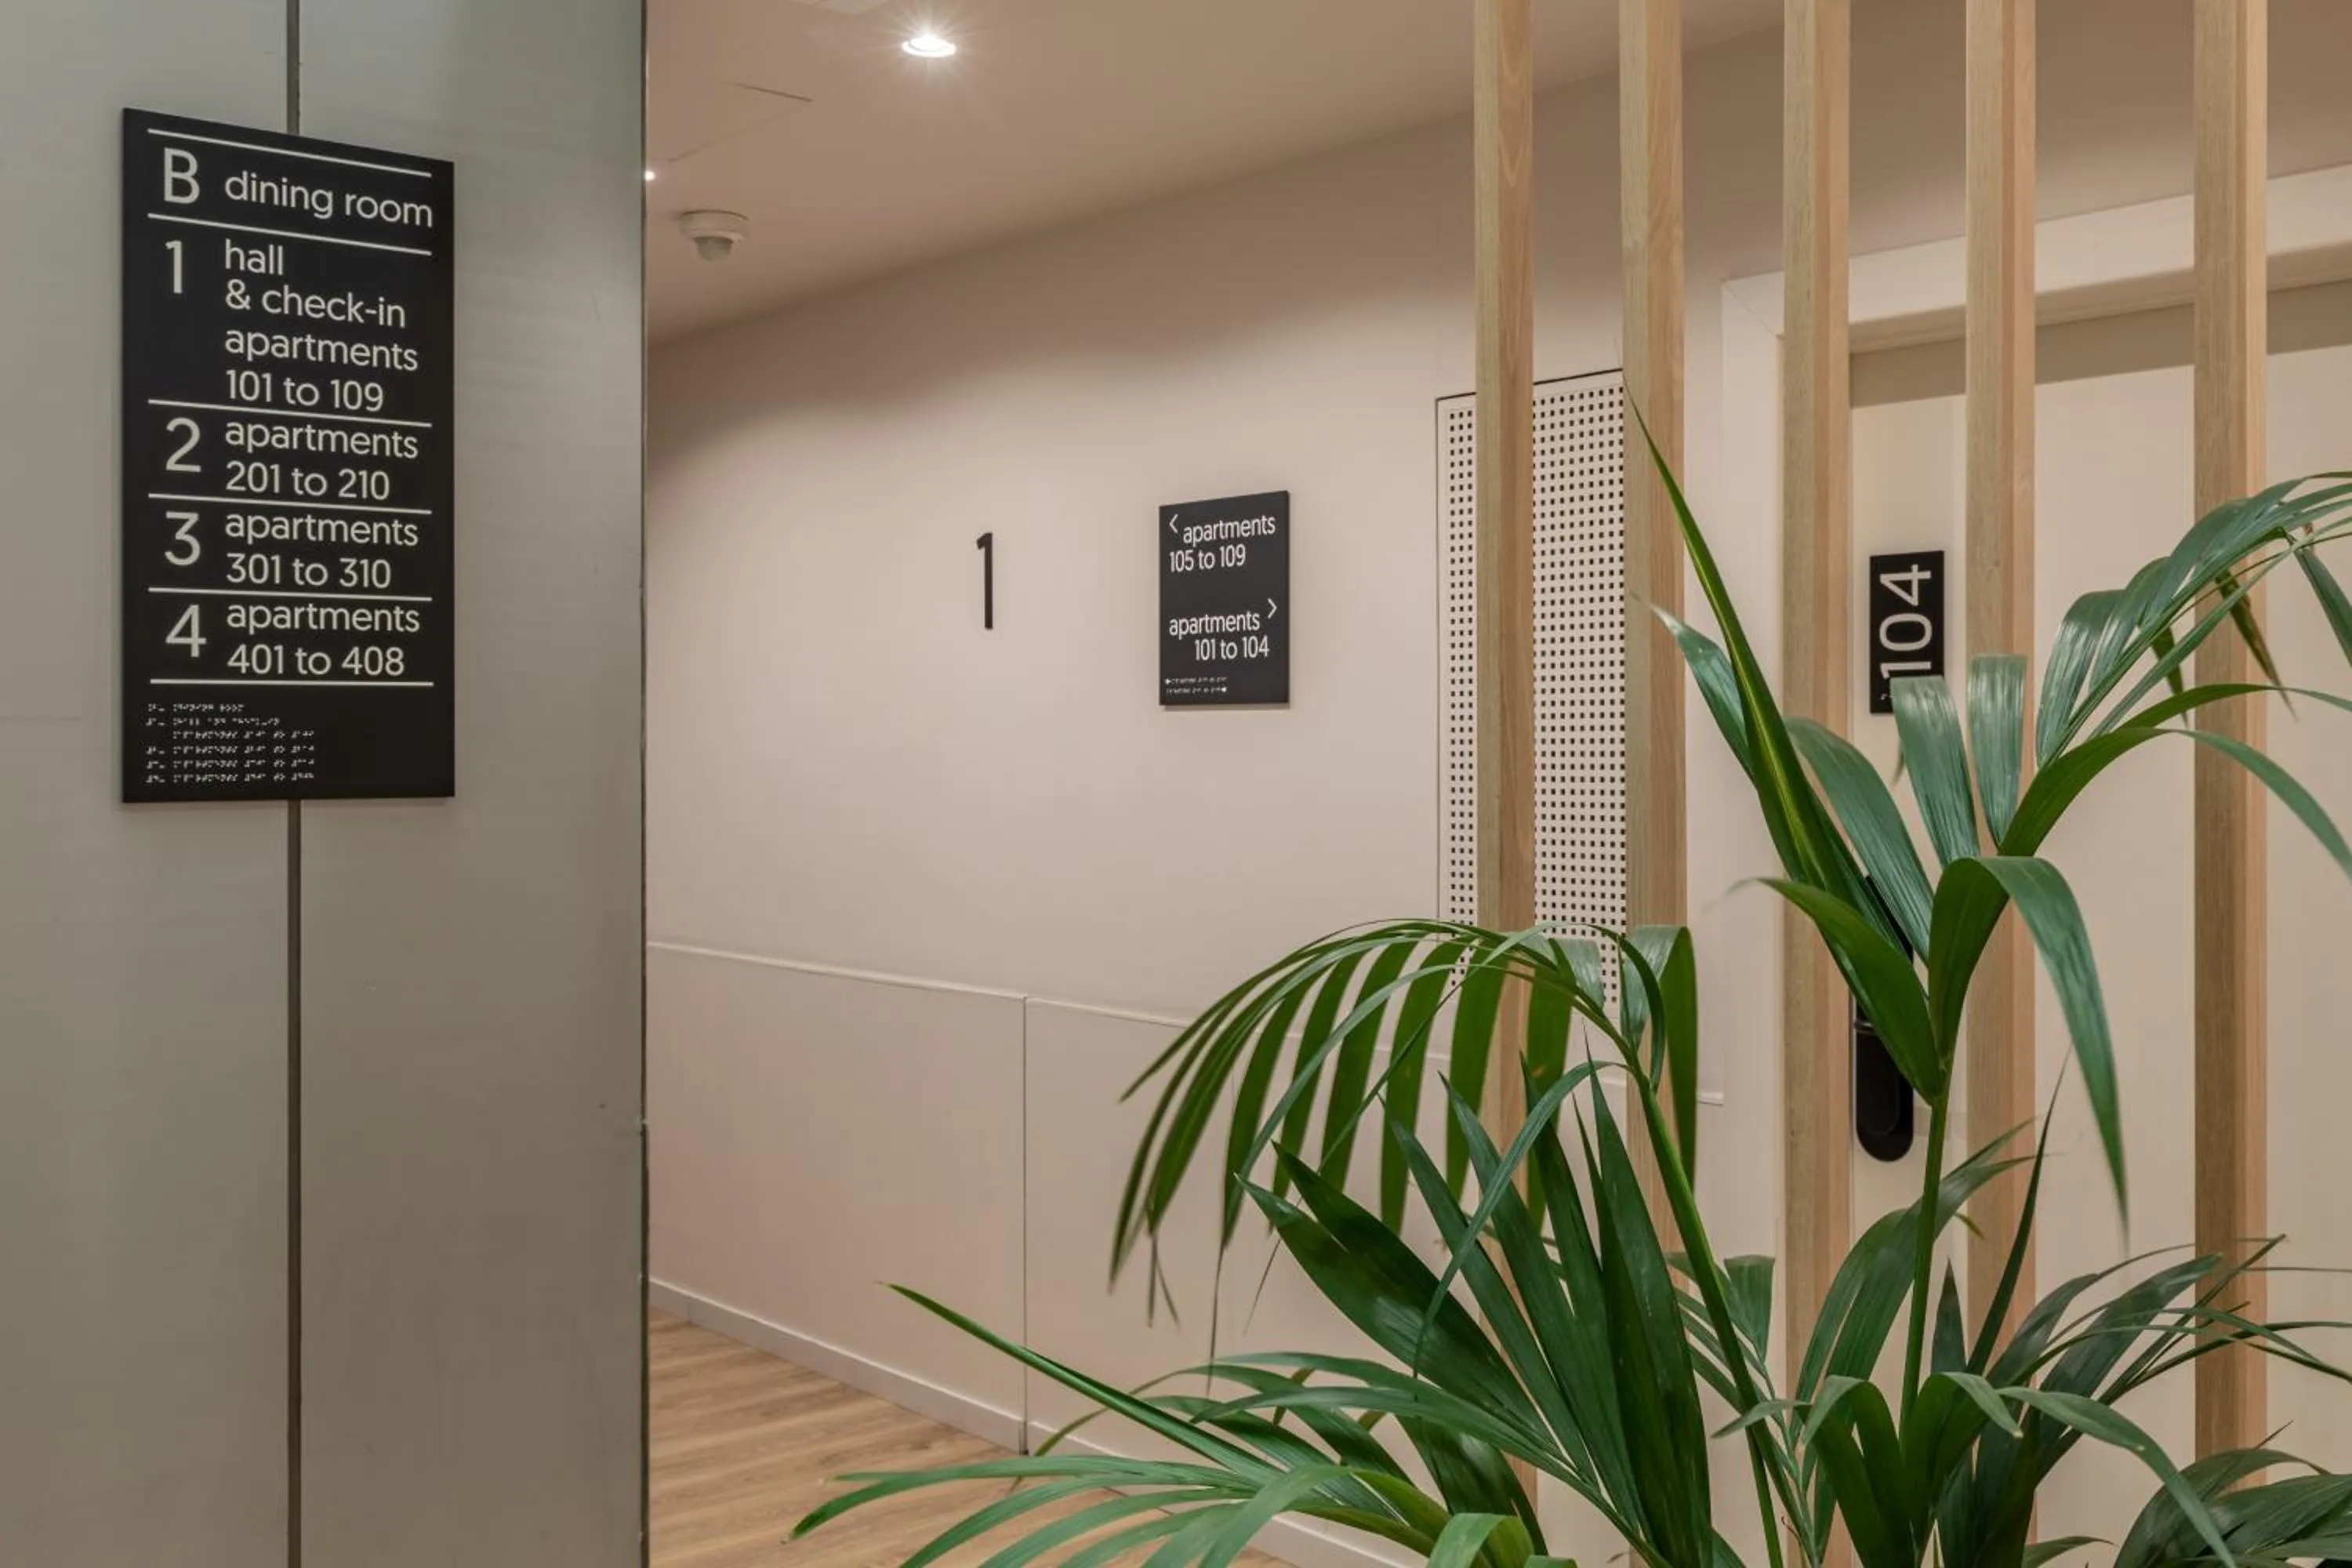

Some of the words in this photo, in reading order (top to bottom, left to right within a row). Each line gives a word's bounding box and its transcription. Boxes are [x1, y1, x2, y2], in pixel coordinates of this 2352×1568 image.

[164, 147, 200, 204] B
[225, 170, 333, 220] dining
[345, 194, 432, 227] room
[165, 240, 183, 294] 1
[225, 238, 283, 275] hall
[225, 278, 251, 310] &
[262, 284, 405, 328] check-in
[226, 330, 418, 372] apartments
[226, 369, 271, 402] 101
[283, 377, 320, 406] to
[330, 379, 383, 412] 109
[165, 417, 201, 473] 2
[226, 422, 419, 458] apartments
[226, 460, 280, 493] 201
[291, 468, 328, 496] to
[338, 468, 390, 500] 210
[165, 511, 201, 566] 3
[226, 514, 419, 546] apartments
[1183, 515, 1276, 547] apartments
[226, 553, 281, 584] 301
[292, 559, 328, 586] to
[339, 557, 391, 589] 310
[1170, 549, 1195, 572] 105
[1197, 550, 1216, 570] to
[1219, 543, 1247, 568] 109
[976, 532, 993, 630] 1
[165, 604, 207, 658] 4
[227, 603, 419, 635] apartments
[1169, 611, 1260, 640] apartments
[1879, 564, 1933, 679] 104
[227, 644, 283, 674] 401
[295, 648, 332, 675] to
[341, 646, 405, 676] 408
[1194, 638, 1216, 661] 101
[1220, 639, 1238, 659] to
[1242, 635, 1270, 659] 104
